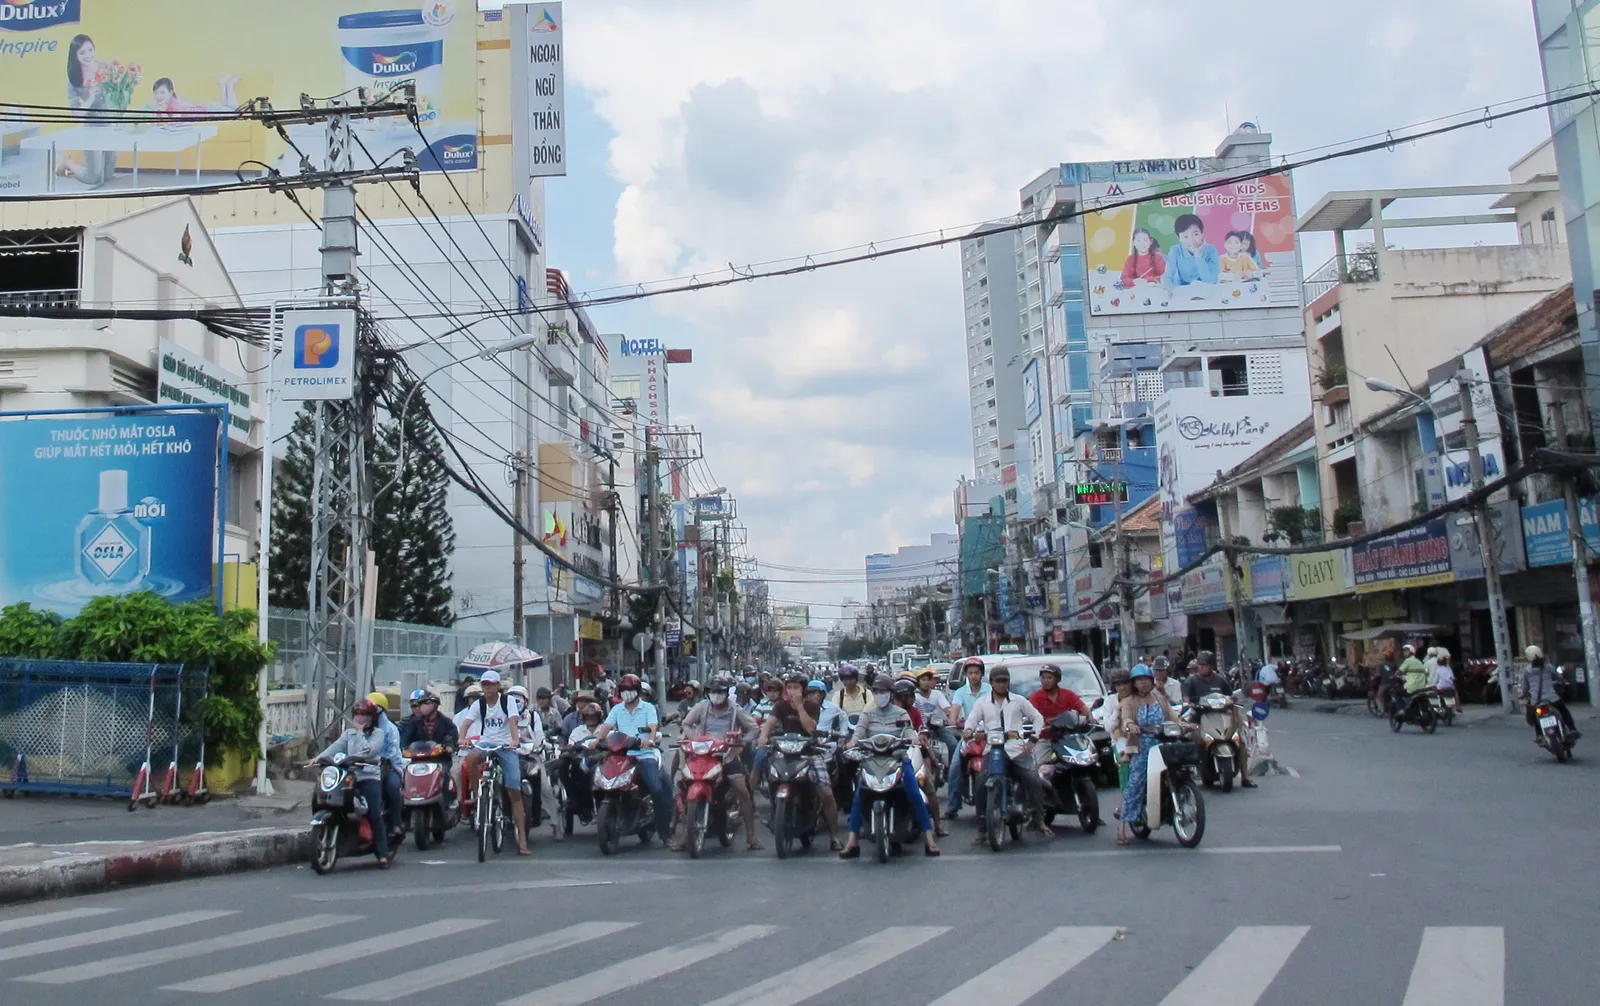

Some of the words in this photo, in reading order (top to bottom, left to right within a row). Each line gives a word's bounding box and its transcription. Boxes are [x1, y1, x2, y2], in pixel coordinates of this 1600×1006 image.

[0, 4, 59, 20] Dulux
[0, 38, 58, 59] Inspire
[530, 44, 560, 66] NGOẠI
[373, 62, 412, 74] Dulux
[535, 73, 556, 97] NGỮ
[533, 103, 560, 130] THẦN
[443, 151, 471, 159] Dulux
[533, 137, 562, 164] ĐỒNG
[1115, 162, 1136, 174] TT.
[1138, 160, 1166, 173] ANH
[0, 180, 21, 189] obel
[1236, 184, 1266, 195] KIDS
[1161, 195, 1213, 207] ENGLISH
[1216, 194, 1234, 204] for
[1238, 201, 1280, 212] TEENS
[284, 377, 347, 386] PETROLIMEX
[51, 426, 89, 441] THUỐC
[92, 425, 117, 440] NHỎ
[120, 423, 144, 438] MẮT
[146, 425, 176, 438] OSLA
[34, 445, 61, 459] GIÚP
[64, 443, 88, 457] MẮT
[90, 441, 111, 456] HẾT
[114, 439, 139, 456] MỎI,
[142, 439, 164, 455] HẾT
[166, 439, 192, 453] KHÔ
[1524, 512, 1562, 537] NAM
[94, 545, 124, 559] OSLA
[1298, 559, 1334, 588] GIAVY
